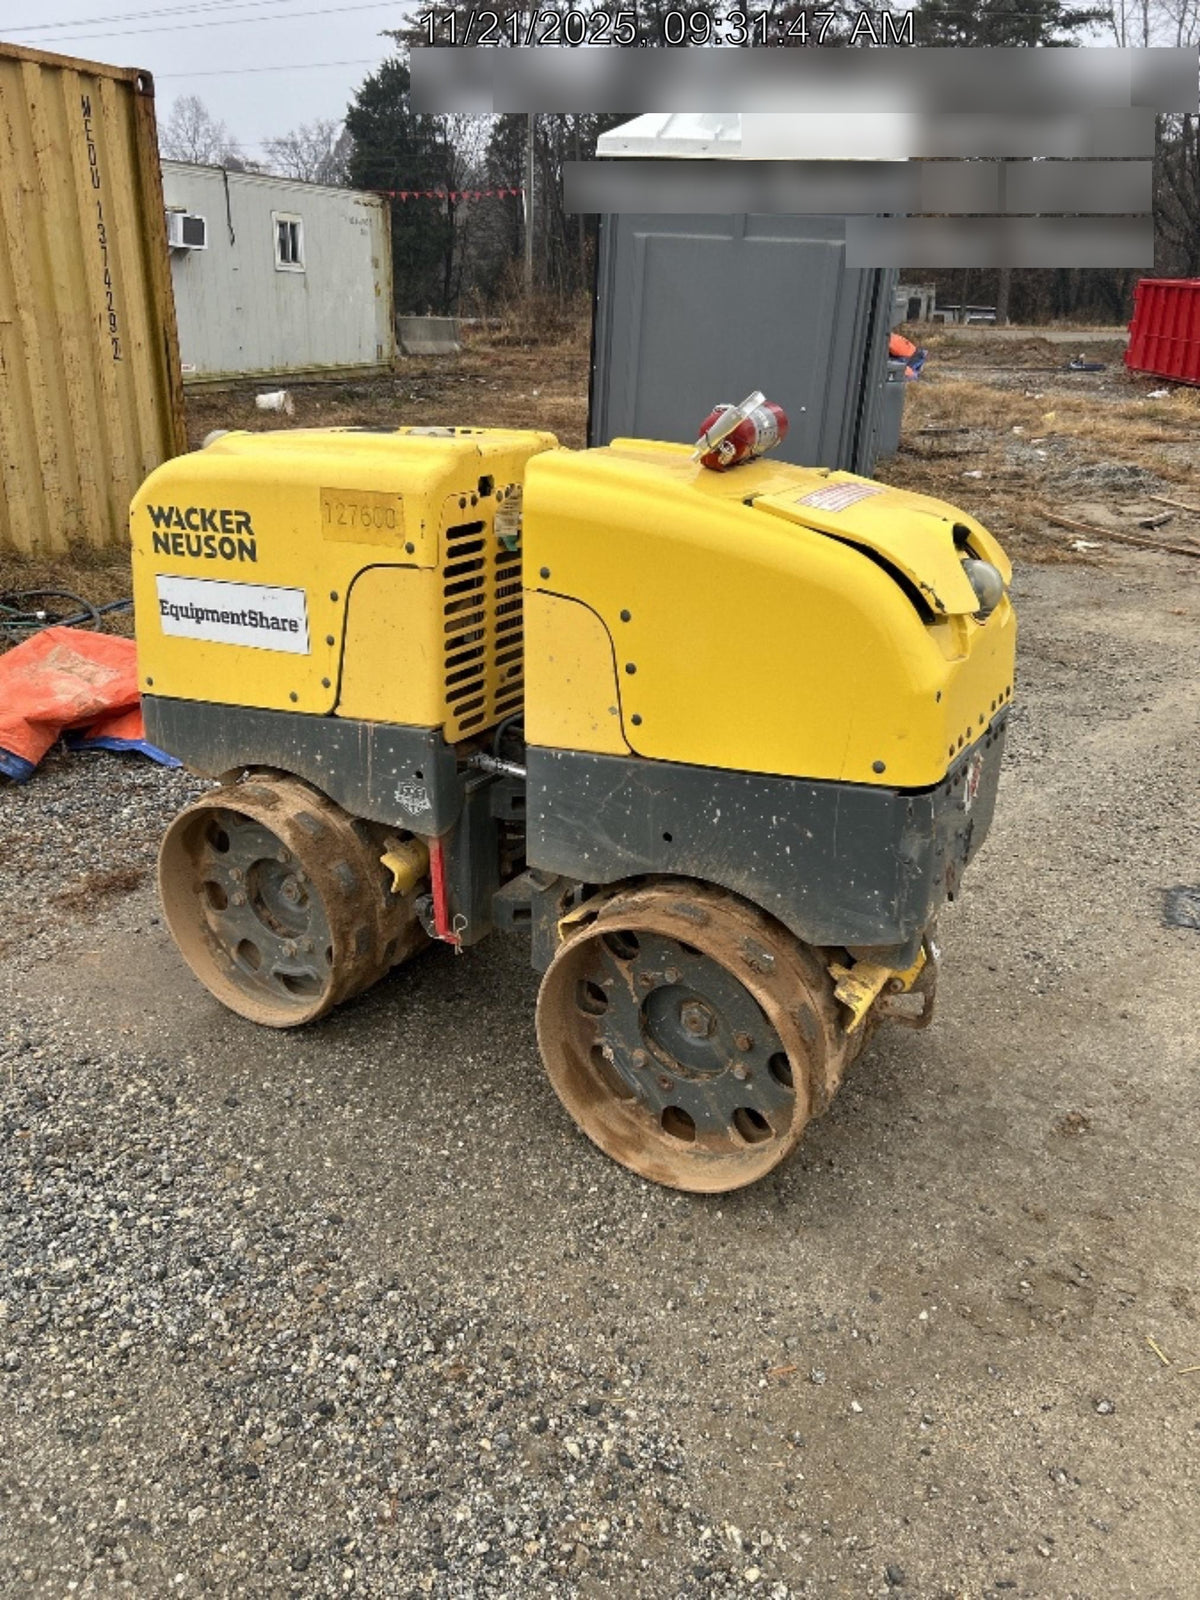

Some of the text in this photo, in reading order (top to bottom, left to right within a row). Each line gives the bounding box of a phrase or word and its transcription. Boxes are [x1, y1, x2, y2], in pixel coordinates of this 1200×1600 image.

[147, 505, 255, 536] WACKER
[324, 502, 396, 529] 127600
[152, 531, 257, 563] NEUSON
[158, 599, 300, 633] EquipmentShare
